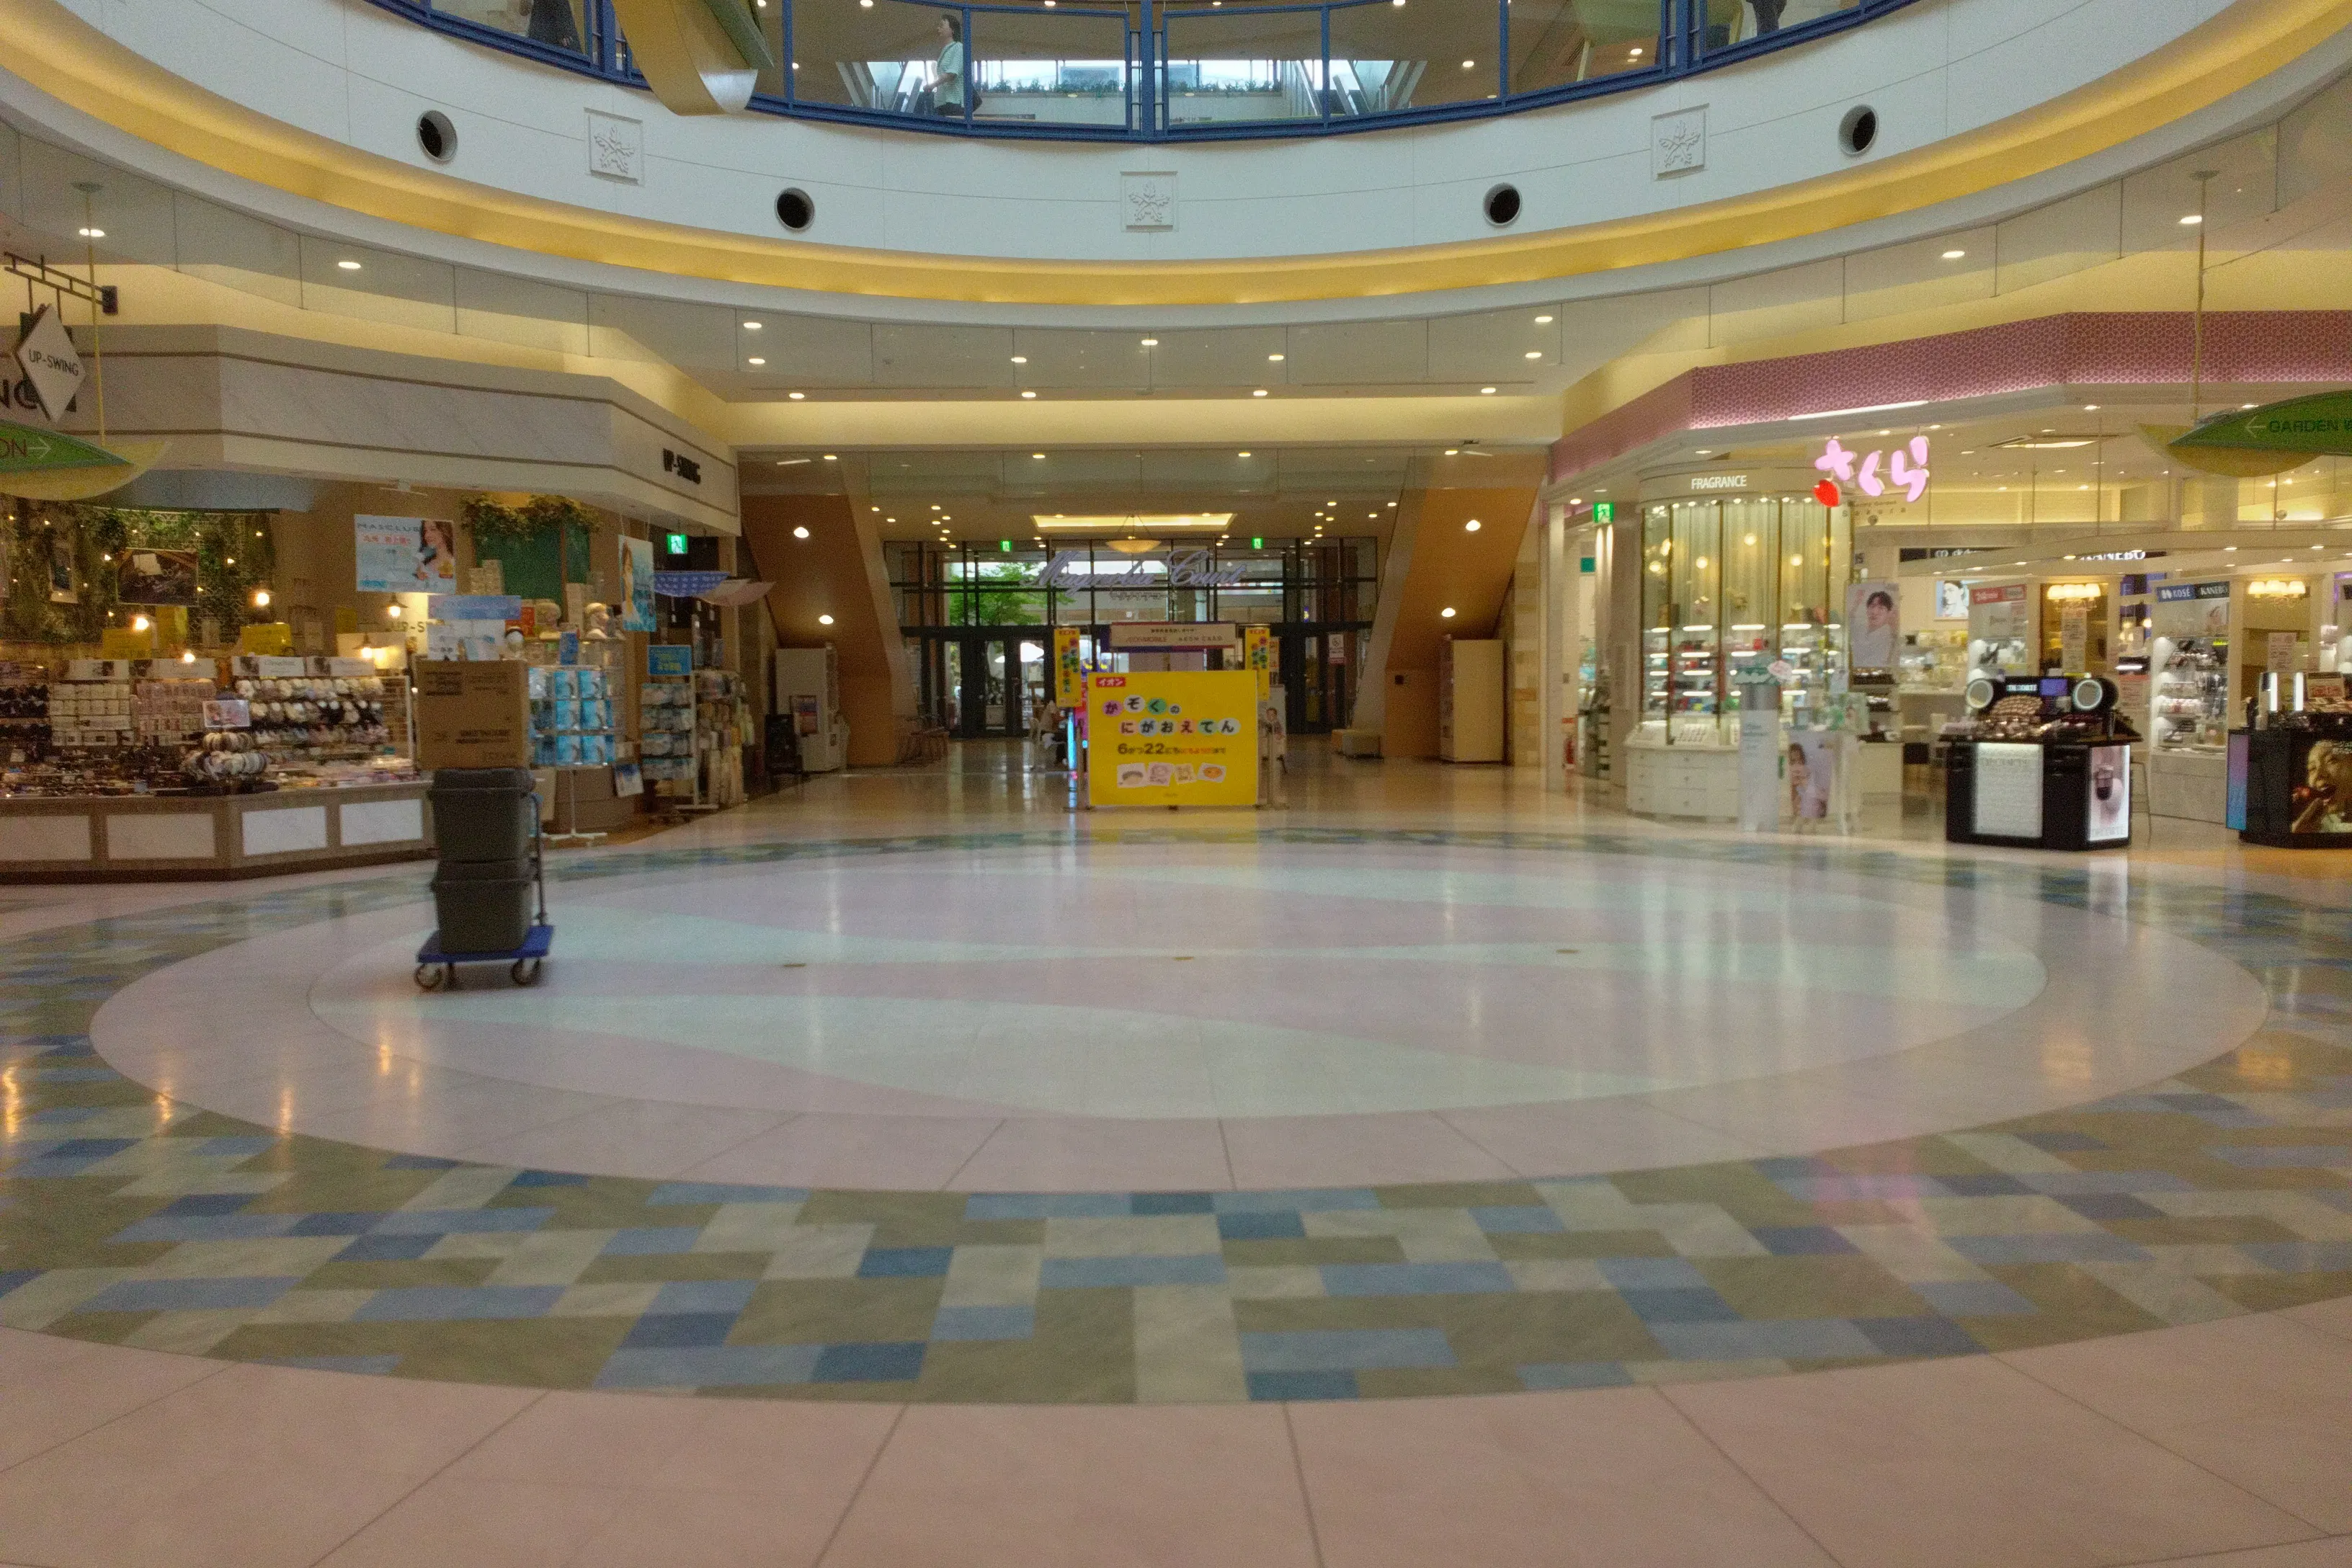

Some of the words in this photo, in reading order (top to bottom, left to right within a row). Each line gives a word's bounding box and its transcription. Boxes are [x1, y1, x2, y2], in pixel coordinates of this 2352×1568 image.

[29, 349, 79, 377] UP-SWING
[2269, 419, 2339, 433] GARDEN
[1690, 475, 1747, 490] FRAGRANCE
[1020, 550, 1154, 595] Magnolia
[1165, 549, 1247, 585] Court
[1097, 678, 1124, 687] イオン
[1104, 696, 1180, 716] かぞくの
[1120, 719, 1235, 734] にがおえてん
